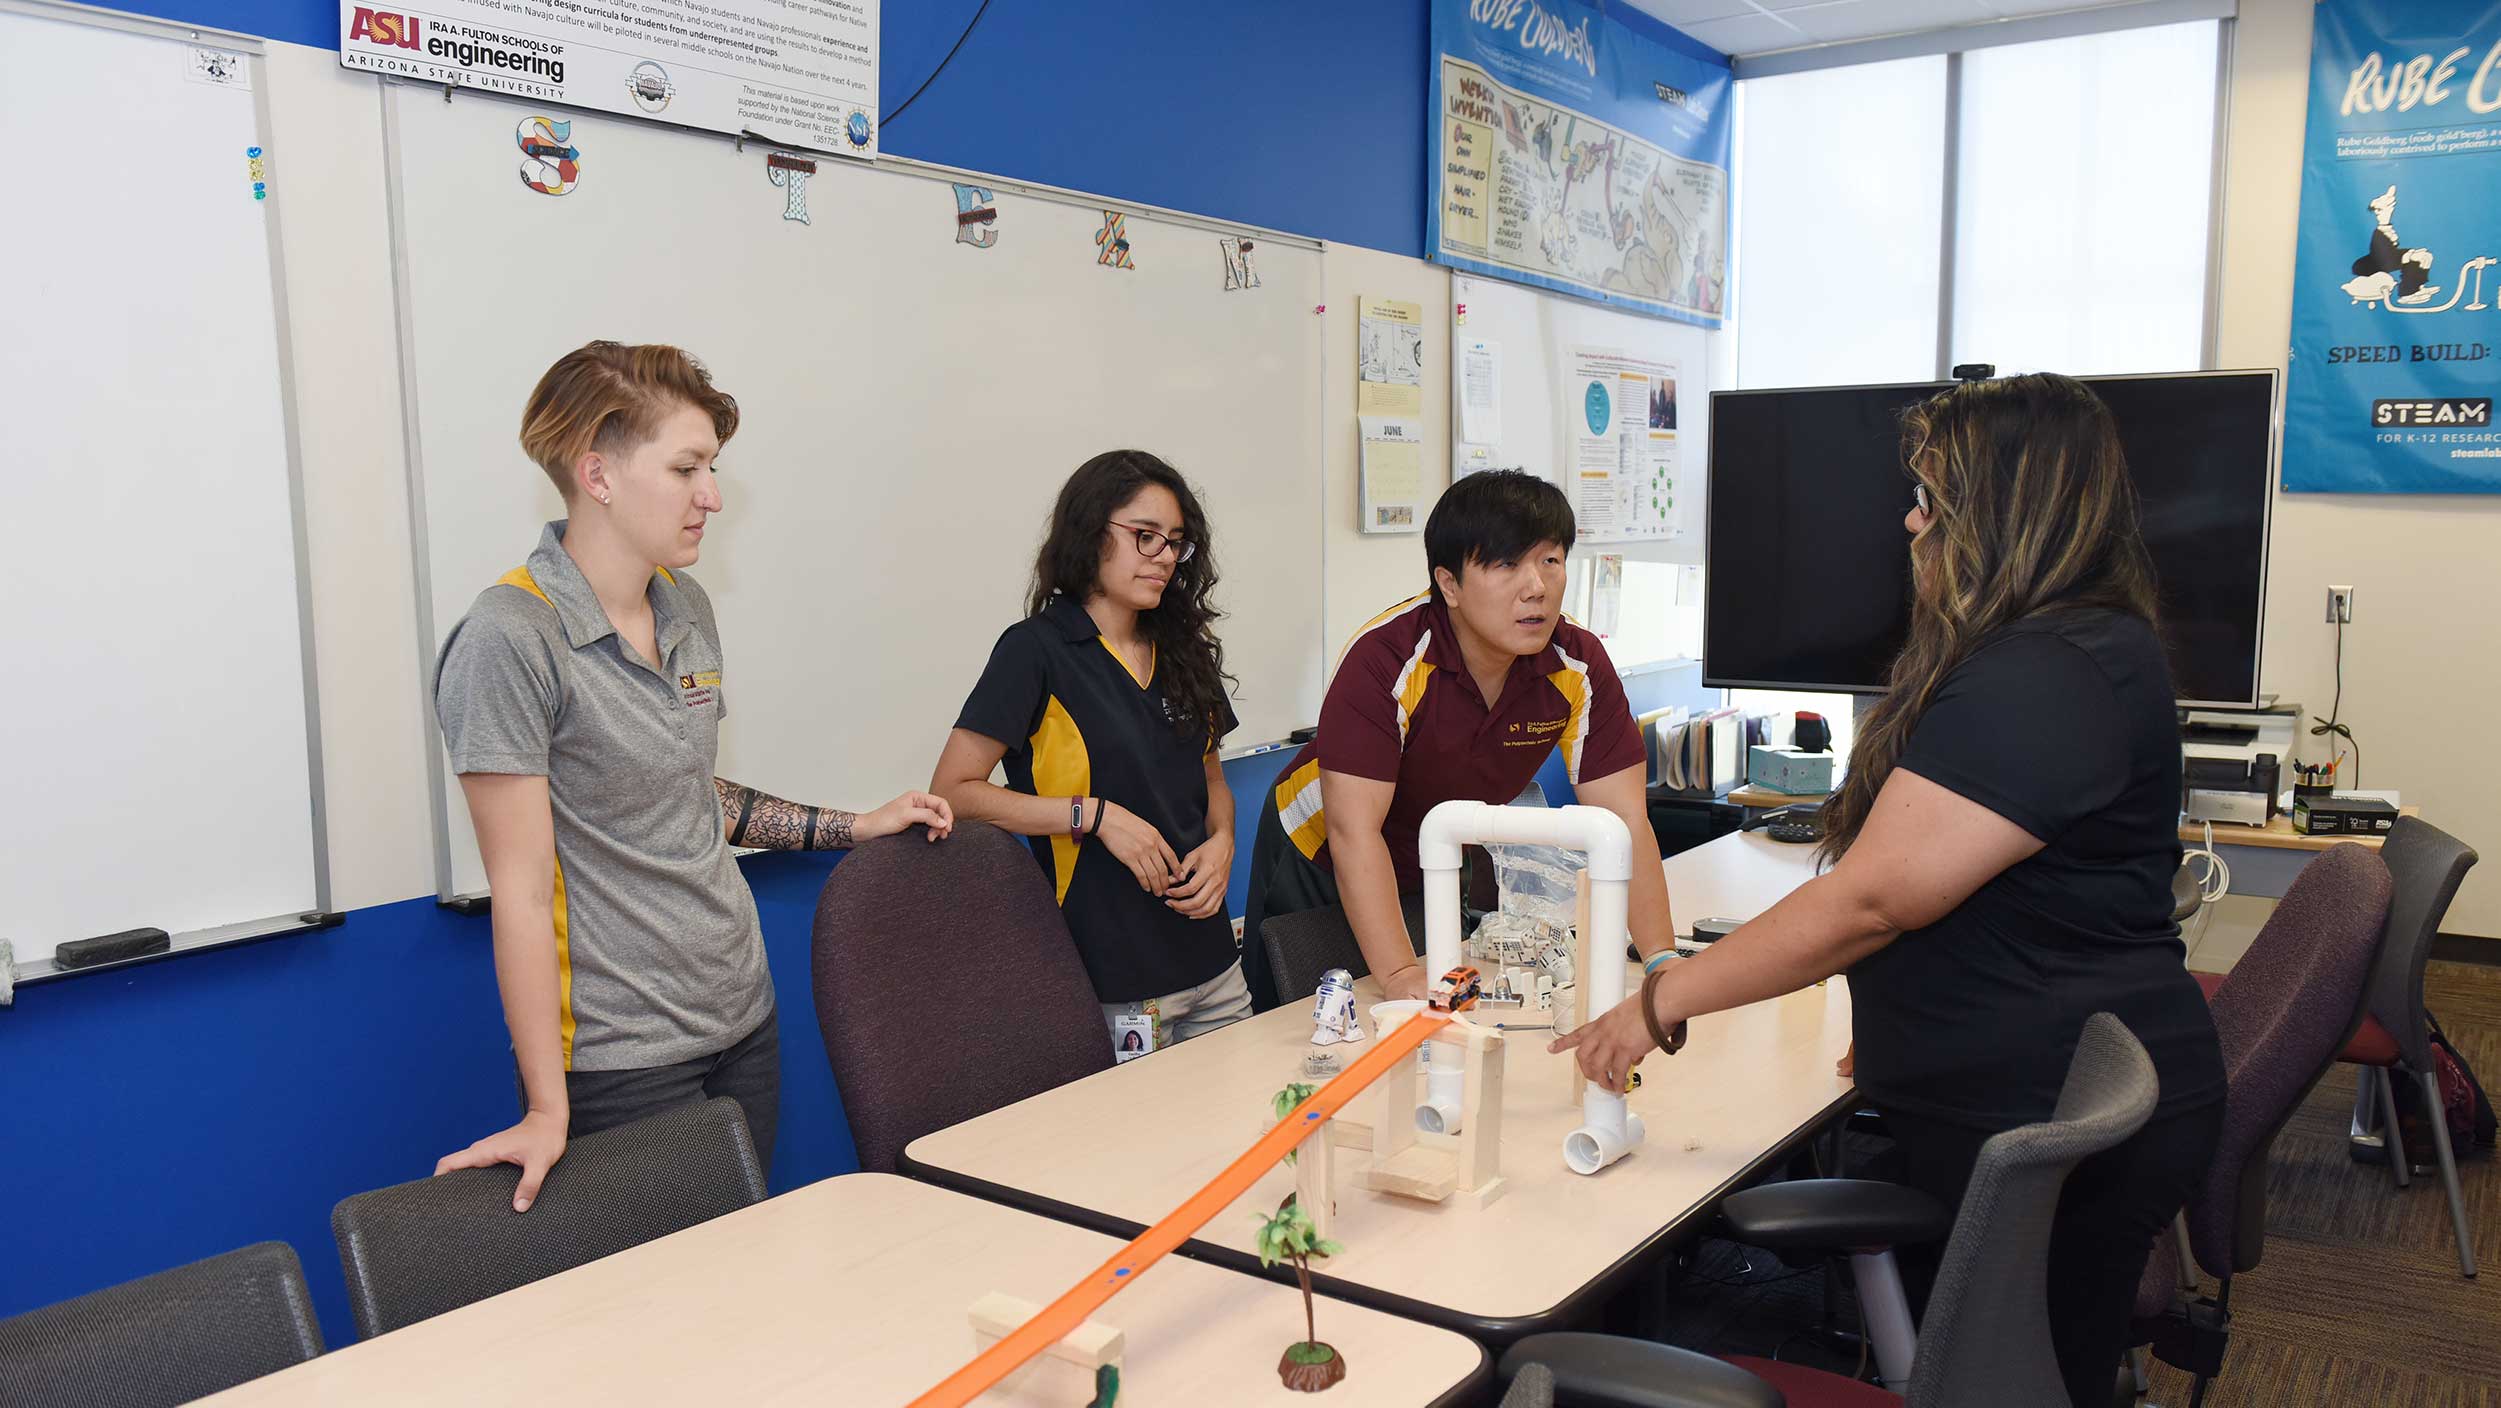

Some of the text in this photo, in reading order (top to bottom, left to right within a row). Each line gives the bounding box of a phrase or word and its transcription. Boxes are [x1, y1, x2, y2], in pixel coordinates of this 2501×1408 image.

[788, 2, 807, 12] career
[809, 7, 838, 20] pathways
[840, 14, 848, 22] for
[849, 16, 868, 28] Native
[852, 6, 863, 14] and
[350, 6, 422, 52] ASU
[430, 21, 564, 56] IRA A. FULTON SCHOOLS OF
[554, 1, 582, 12] design
[584, 6, 619, 20] curricula
[620, 12, 632, 23] for
[634, 16, 668, 32] students
[670, 24, 688, 36] from
[690, 29, 754, 52] underrepresented
[754, 45, 778, 57] groups
[641, 4, 684, 22] community,
[687, 15, 700, 24] and
[702, 20, 728, 32] society,
[730, 26, 743, 36] and
[744, 30, 756, 38] are
[757, 32, 775, 44] using
[776, 36, 788, 46] the
[788, 40, 810, 52] results
[811, 45, 818, 53] to
[819, 47, 842, 60] develop
[848, 56, 872, 67] method
[684, 2, 709, 14] Navajo
[711, 8, 740, 20] students
[742, 16, 755, 24] and
[756, 18, 779, 31] Navajo
[780, 24, 821, 41] professionals
[822, 36, 856, 50] experience
[857, 45, 868, 54] and
[502, 4, 522, 14] with
[525, 8, 554, 21] Navajo
[556, 15, 585, 27] culture
[587, 21, 601, 30] will
[603, 23, 614, 33] be
[615, 27, 642, 40] piloted
[644, 32, 652, 41] in
[654, 36, 680, 48] several
[682, 42, 706, 54] middle
[708, 46, 734, 60] schools
[735, 54, 744, 62] on
[746, 56, 757, 66] the
[758, 58, 781, 71] Navajo
[782, 63, 804, 76] Nation
[805, 70, 819, 80] over
[820, 72, 831, 81] the
[832, 76, 845, 86] next
[428, 36, 564, 84] engineering
[348, 54, 564, 99] ARIZONA STATE UNIVERSITY
[2340, 46, 2470, 117] RUBE
[738, 98, 840, 124] supported by the National Science
[742, 85, 840, 112] This material is based upon work
[738, 110, 840, 135] Foundation under Grant No. EEC-
[848, 122, 870, 138] NSF
[1454, 123, 1473, 144] OUR
[2336, 138, 2362, 148] Rube
[2363, 135, 2408, 148] Goldberg
[2336, 147, 2389, 158] laboriously
[2390, 143, 2436, 154] contrived
[2437, 143, 2448, 152] to
[2448, 140, 2489, 152] perform
[1446, 162, 1486, 182] SIMPLIFIED
[2328, 343, 2491, 364] SPEED BUILD:
[2377, 403, 2486, 424] STEAM
[1384, 425, 1402, 436] JUNE
[2376, 434, 2402, 442] FOR
[2407, 434, 2436, 442] K-12
[1527, 720, 1566, 735] Engineering
